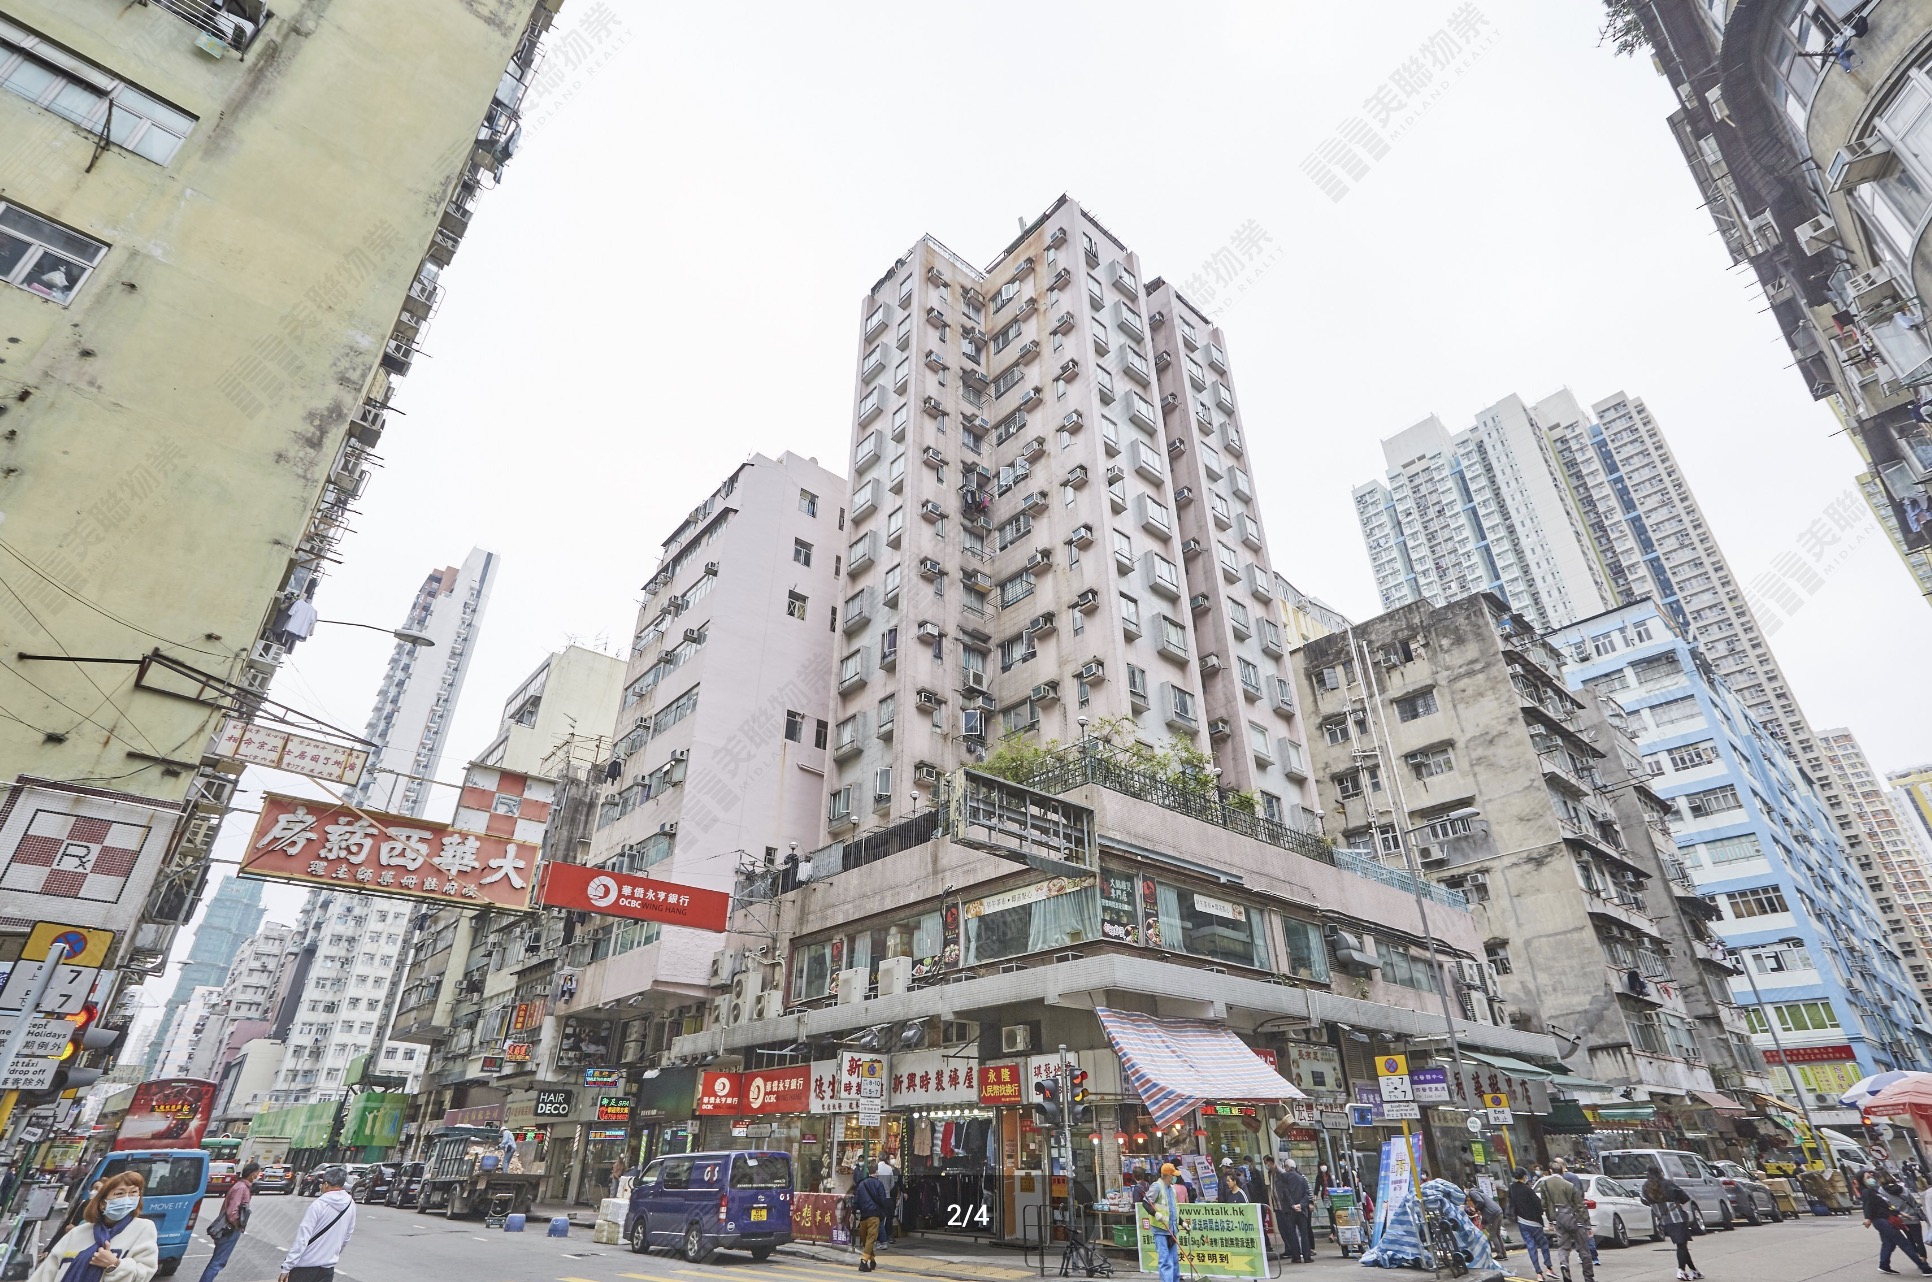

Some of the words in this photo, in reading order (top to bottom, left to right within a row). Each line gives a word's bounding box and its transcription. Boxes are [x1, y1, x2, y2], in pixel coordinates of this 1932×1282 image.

[621, 885, 690, 907] 華僑永亨銀行
[619, 898, 641, 909] OCBC
[642, 904, 663, 912] WING
[664, 906, 687, 916] HANG
[68, 970, 82, 984] 7
[57, 994, 72, 1009] 7
[987, 1068, 1011, 1083] 永隆
[765, 1077, 804, 1092] 華僑永亨銀行
[980, 1083, 1019, 1097] 人民幣找換行
[540, 1092, 565, 1103] HAIR
[764, 1095, 777, 1103] OCBC
[537, 1103, 569, 1114] DECO
[149, 1202, 175, 1210] MOVE
